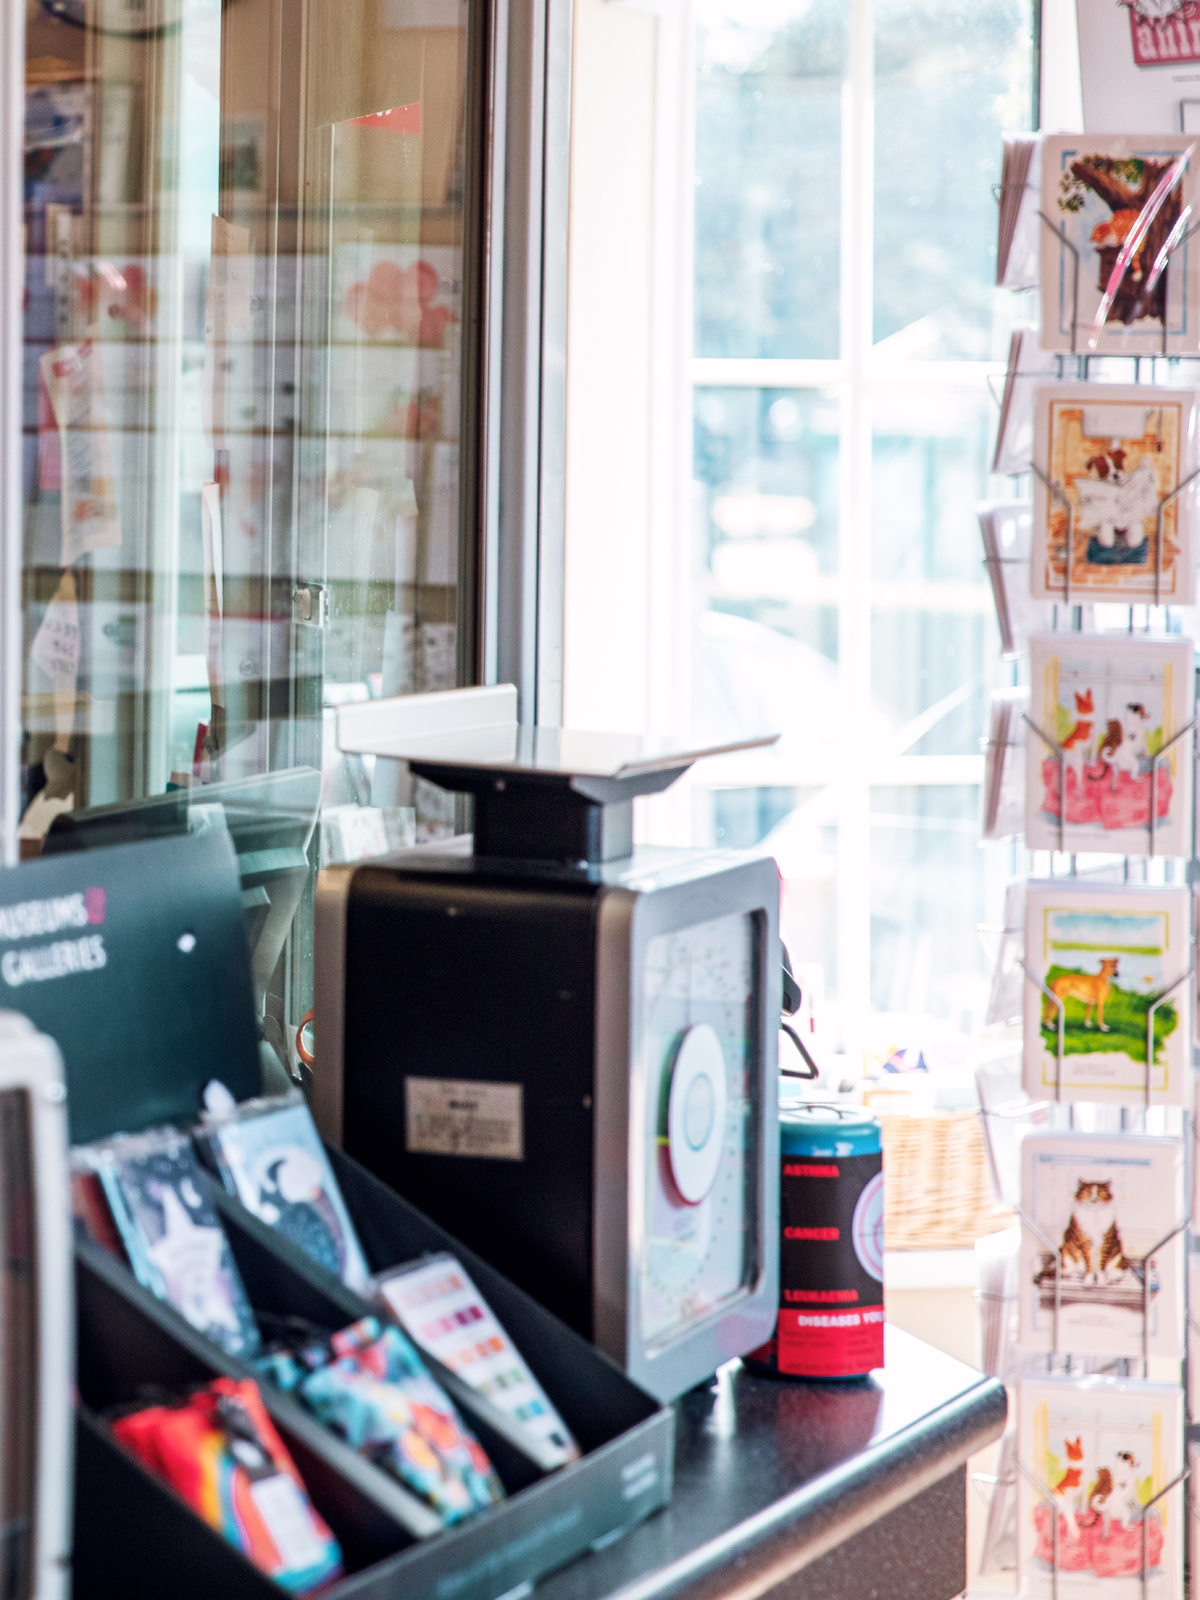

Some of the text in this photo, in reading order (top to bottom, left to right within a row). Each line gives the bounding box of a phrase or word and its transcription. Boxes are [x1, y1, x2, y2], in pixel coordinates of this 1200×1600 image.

[1, 934, 107, 987] GALLERIES
[783, 1163, 840, 1178] ASTHMA
[783, 1226, 840, 1241] CANCER
[797, 1312, 861, 1327] DISEASES
